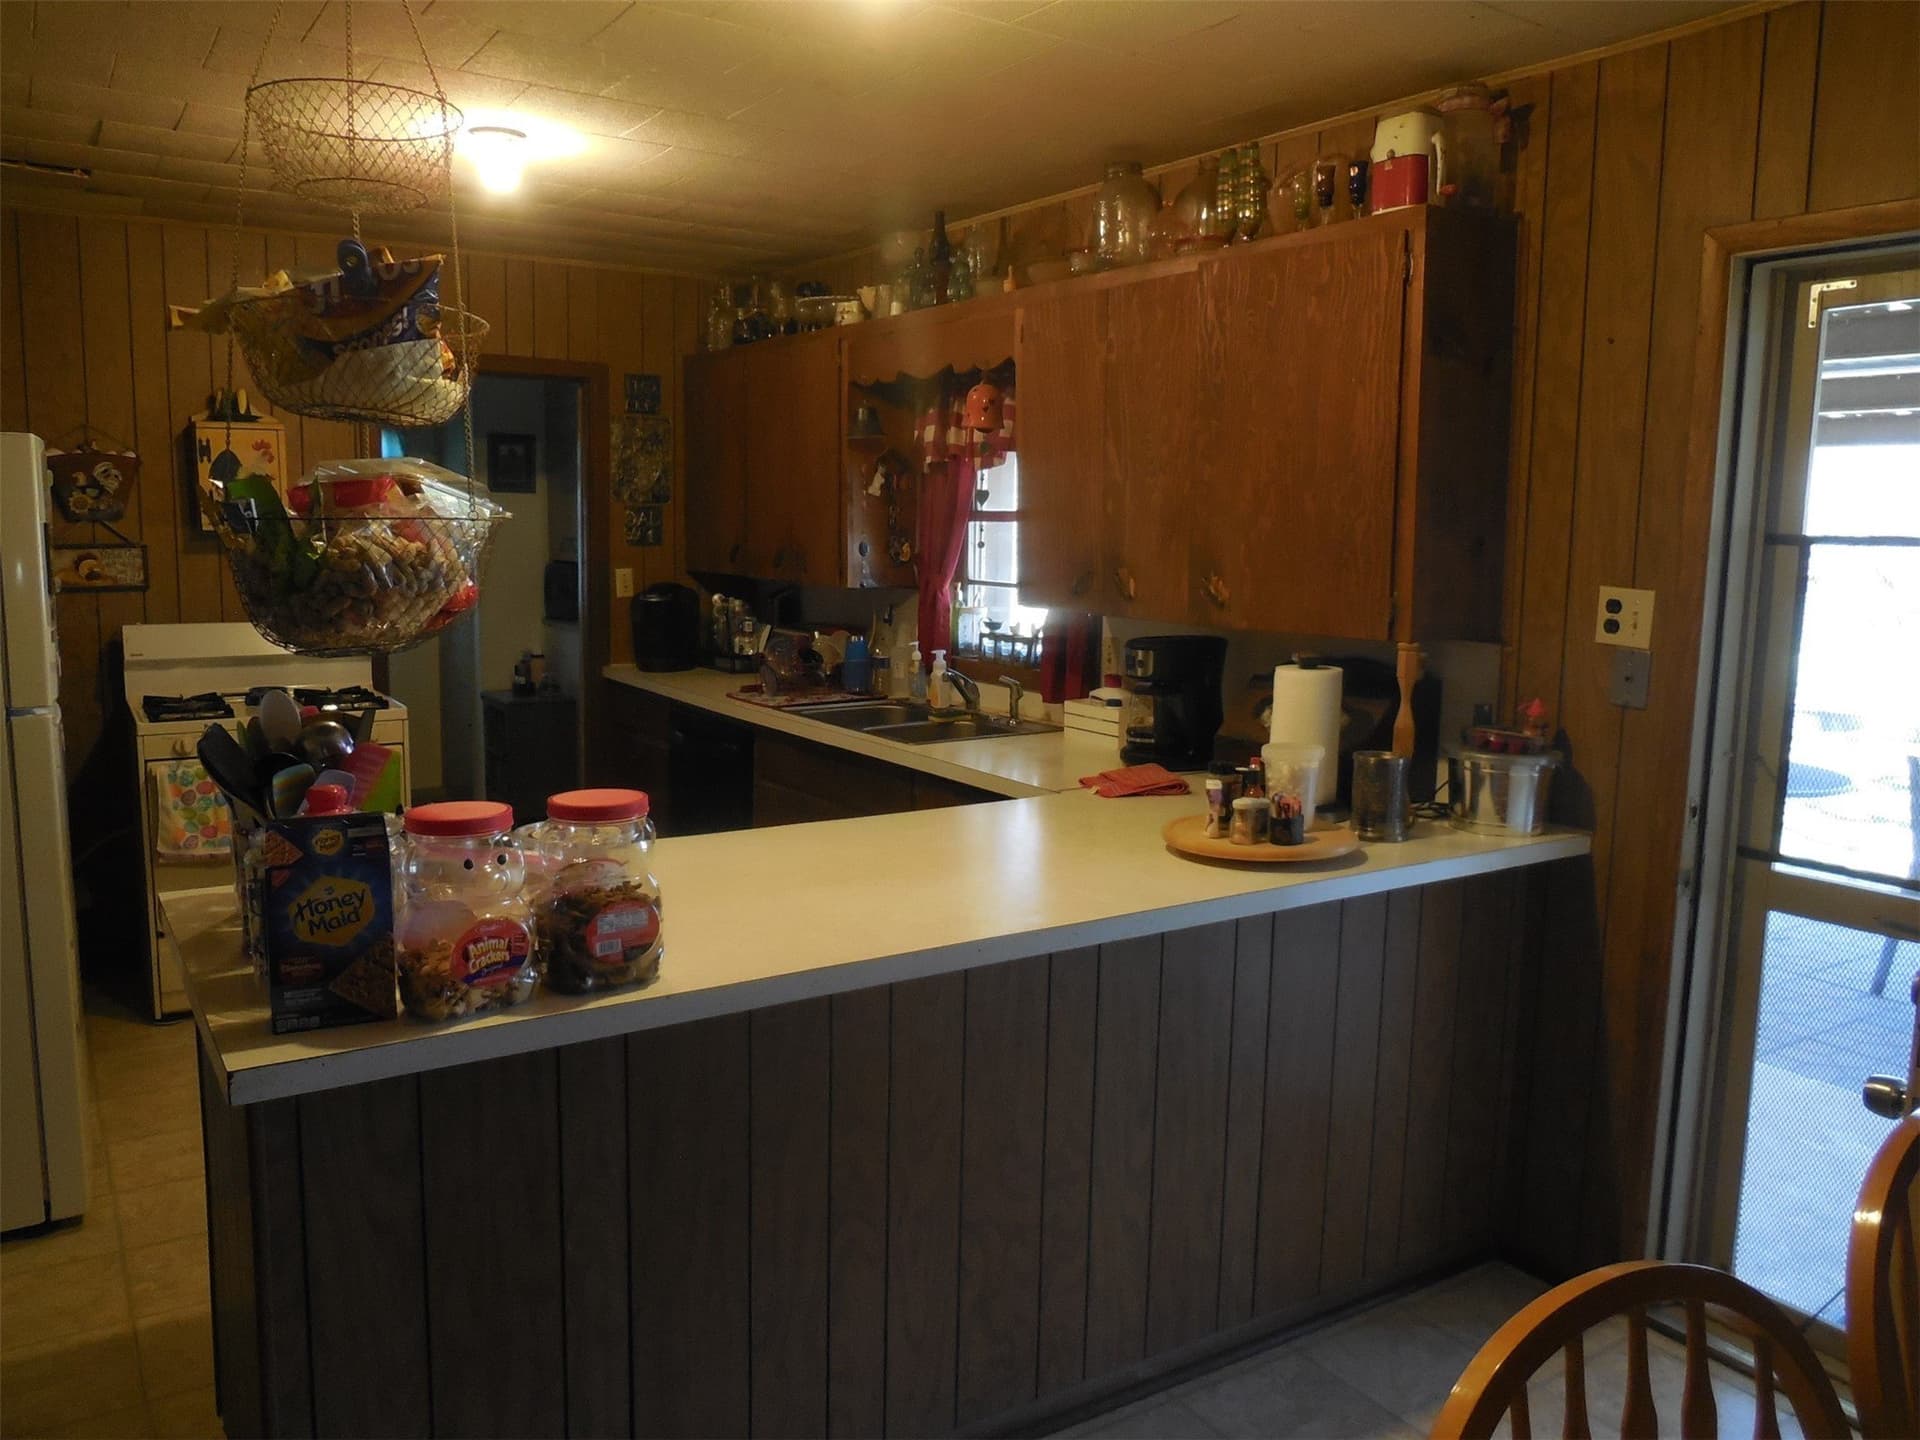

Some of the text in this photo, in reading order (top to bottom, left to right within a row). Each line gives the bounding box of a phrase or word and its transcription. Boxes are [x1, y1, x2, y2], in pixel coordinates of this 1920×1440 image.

[295, 888, 366, 923] Honey
[308, 911, 361, 937] Maid
[467, 935, 510, 961] Animal
[469, 950, 510, 974] Crackers
